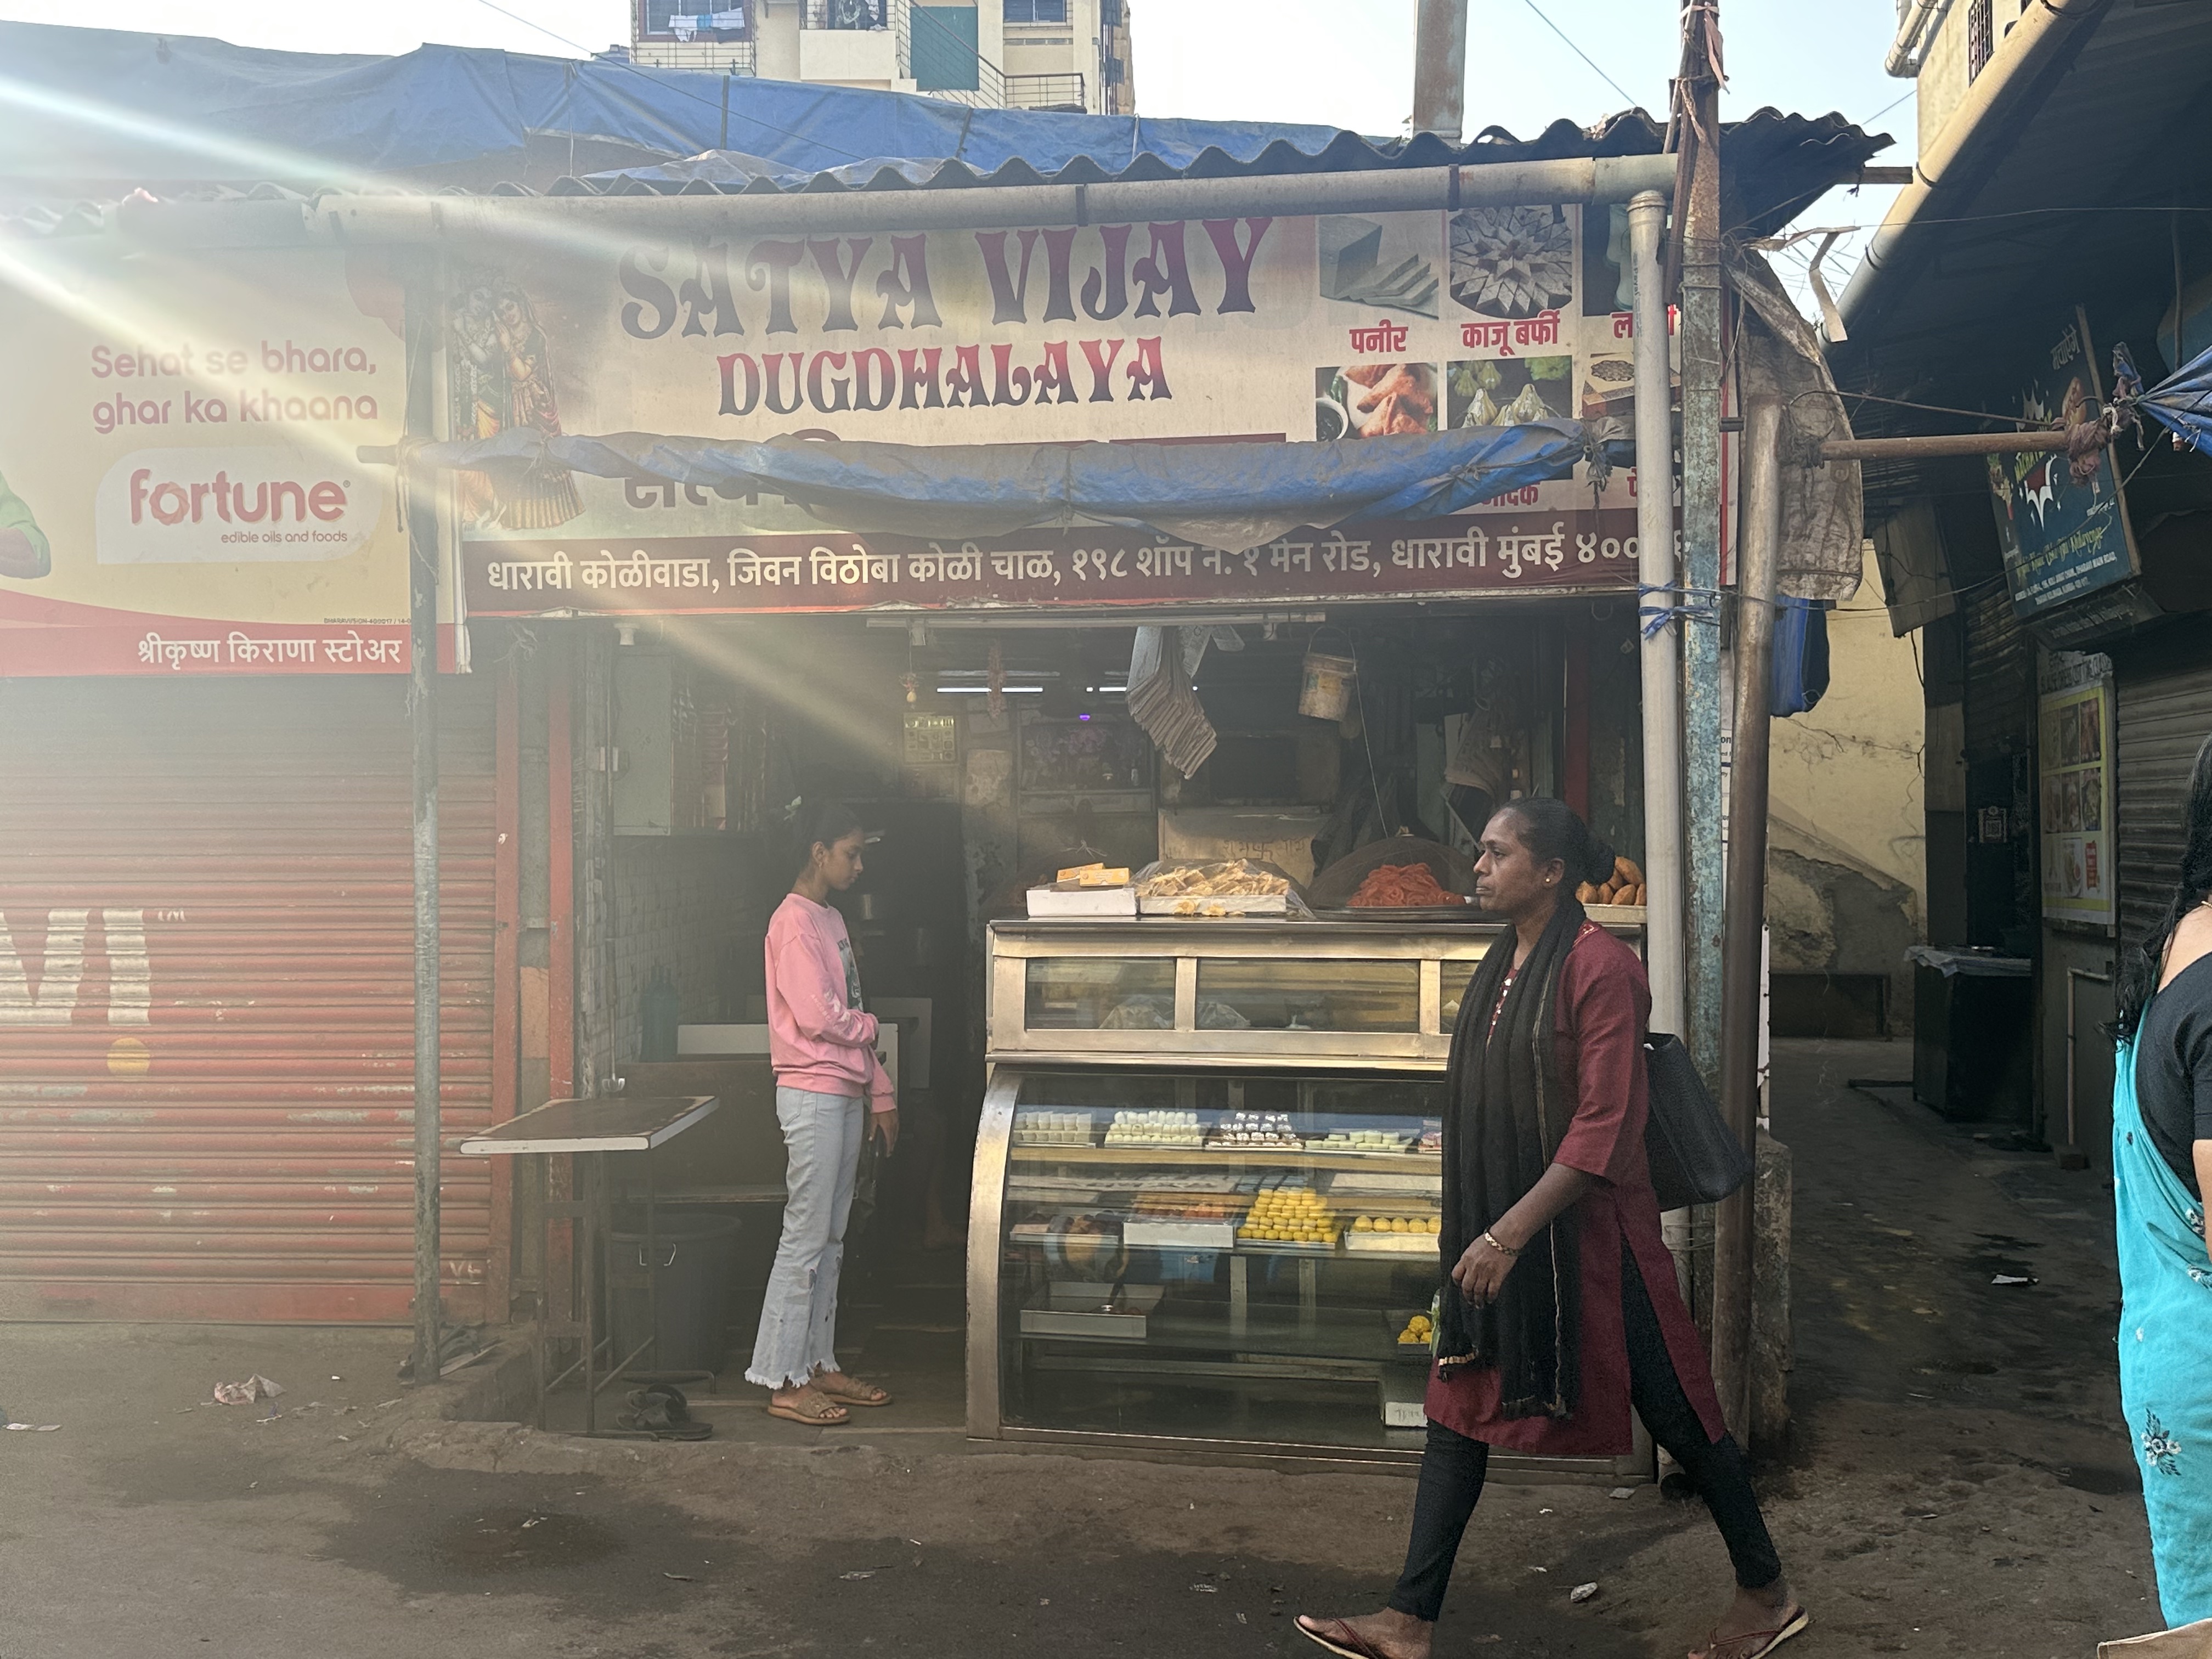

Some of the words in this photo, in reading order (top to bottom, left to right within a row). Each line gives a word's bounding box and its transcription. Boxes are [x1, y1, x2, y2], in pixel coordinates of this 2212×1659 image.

[619, 233, 943, 340] SATYA
[975, 217, 1272, 326] VIJAY
[1350, 320, 1408, 353] पनीर
[1460, 321, 1515, 356] काजू
[1514, 311, 1561, 346] बर्फी
[92, 343, 193, 379] Sehat
[206, 349, 247, 371] se
[262, 341, 376, 375] bhara,
[716, 337, 1172, 416] DUGDHALAYA
[93, 393, 171, 434] ghar
[184, 391, 227, 423] ka
[240, 391, 377, 421] khaana
[221, 531, 258, 543] edible
[262, 531, 283, 543] oils
[285, 531, 308, 543] and
[312, 530, 347, 543] foods
[488, 551, 572, 590] धारावी
[582, 550, 719, 593] कोळीवाडा,
[727, 548, 801, 585] जिवन
[809, 544, 899, 585] विठोबा
[908, 543, 982, 583] कोळी
[991, 551, 1060, 585] चाळ,
[1072, 548, 1128, 579] १९८
[1322, 531, 1380, 578] रोड,
[1392, 526, 1489, 569] धारावी
[1497, 522, 1565, 578] मुंबई
[138, 631, 220, 670] श्रीकृष्ण
[227, 631, 317, 664] किराणा
[323, 631, 402, 664] स्टोअर
